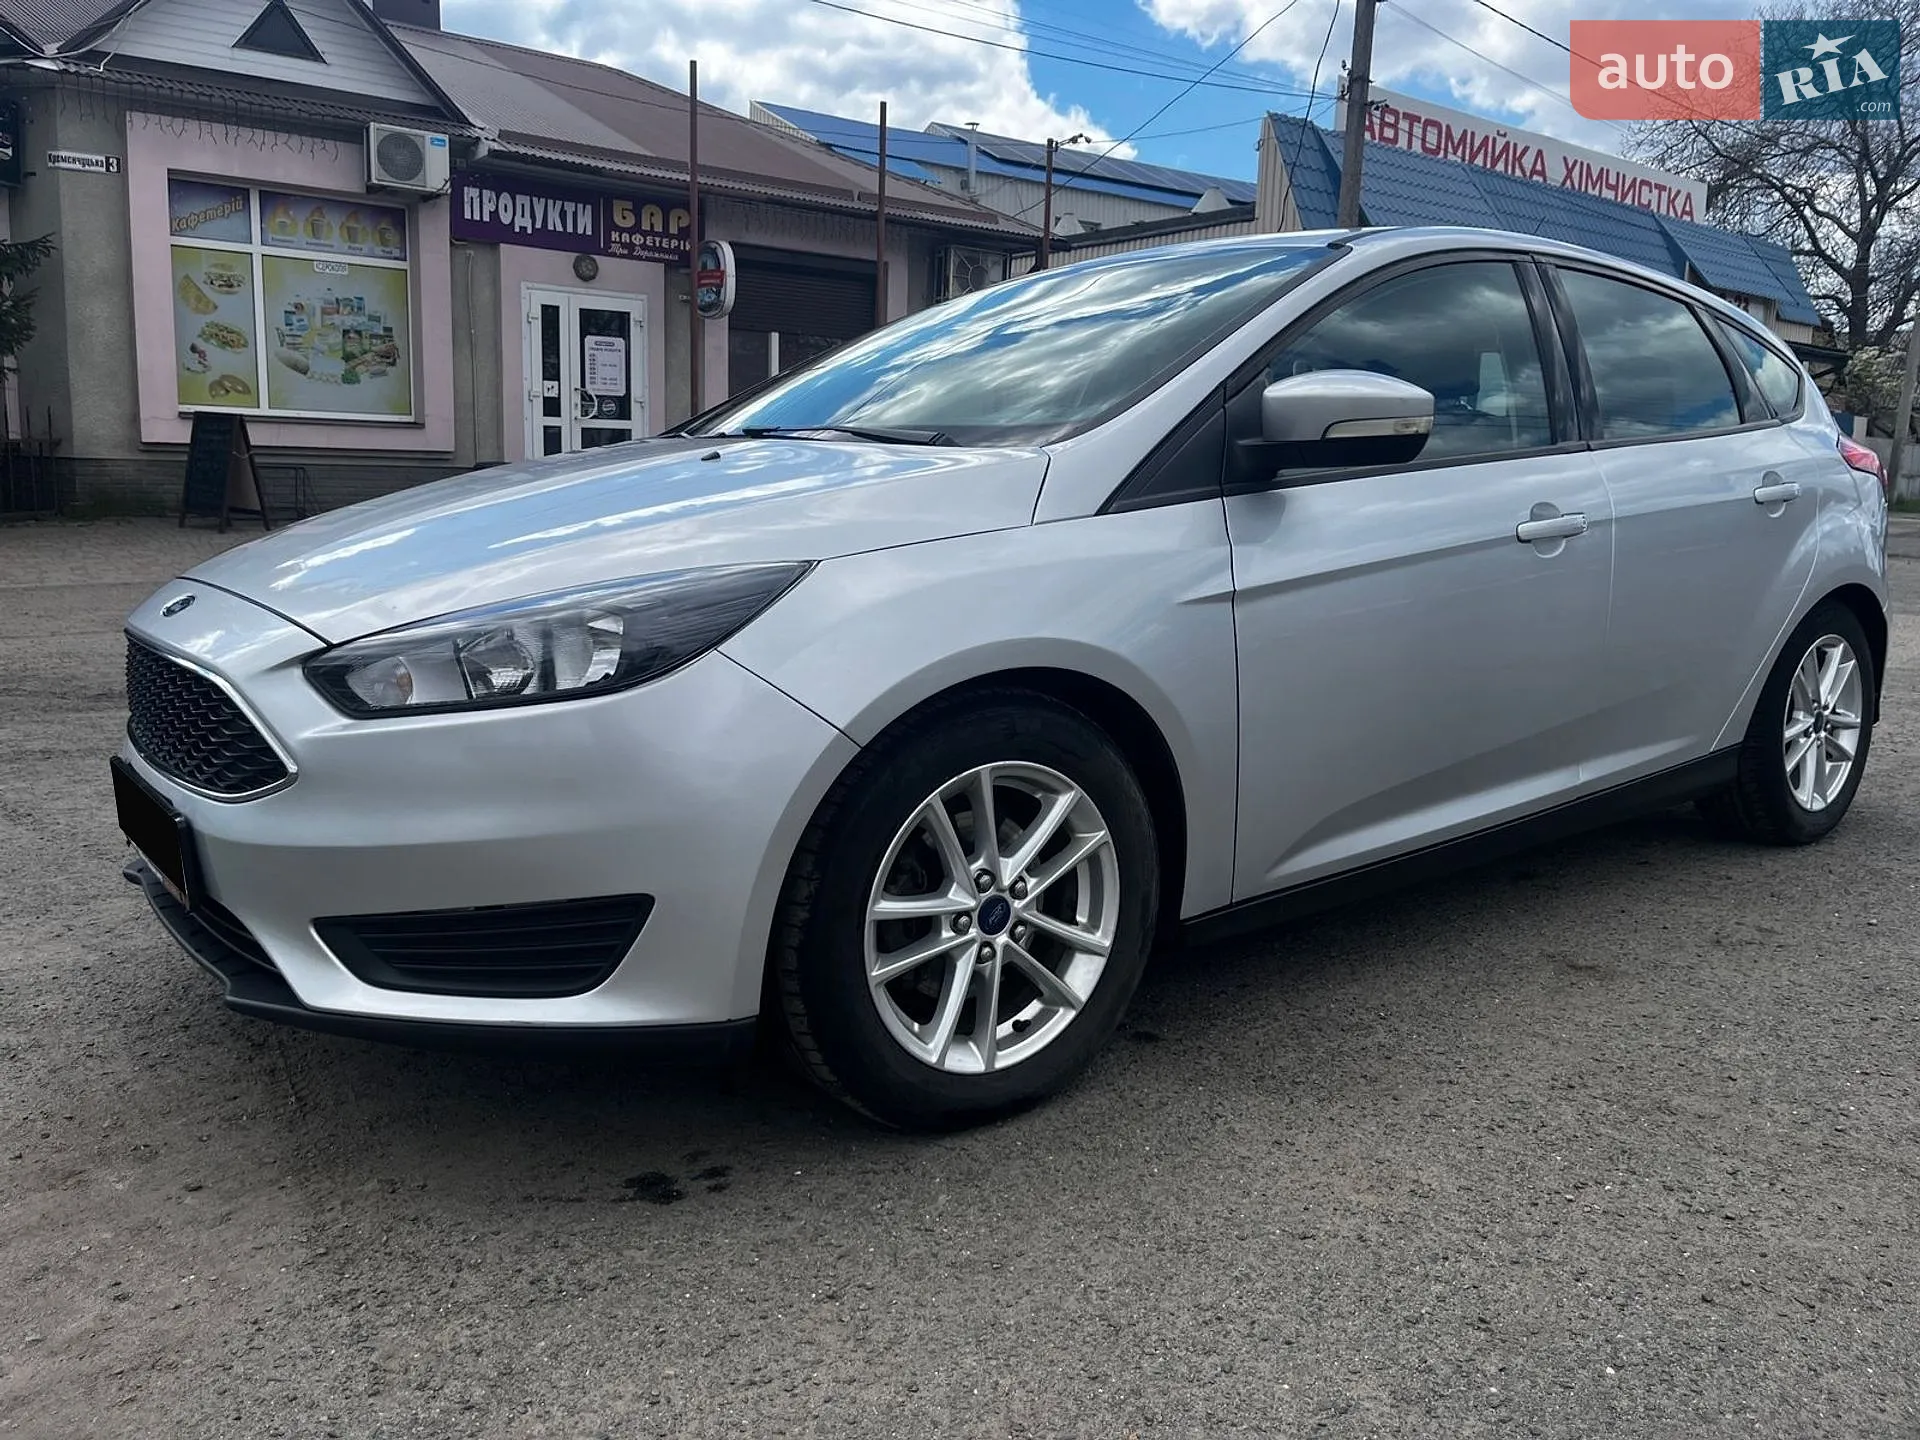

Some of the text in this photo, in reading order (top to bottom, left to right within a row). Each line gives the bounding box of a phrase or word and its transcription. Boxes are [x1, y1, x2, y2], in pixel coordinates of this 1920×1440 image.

[108, 157, 119, 172] 3
[1364, 106, 1695, 222] АВТОМИЙКА ХІМЧИСТКА
[463, 186, 593, 236] ПРОДУКТИ
[612, 199, 691, 235] БАР
